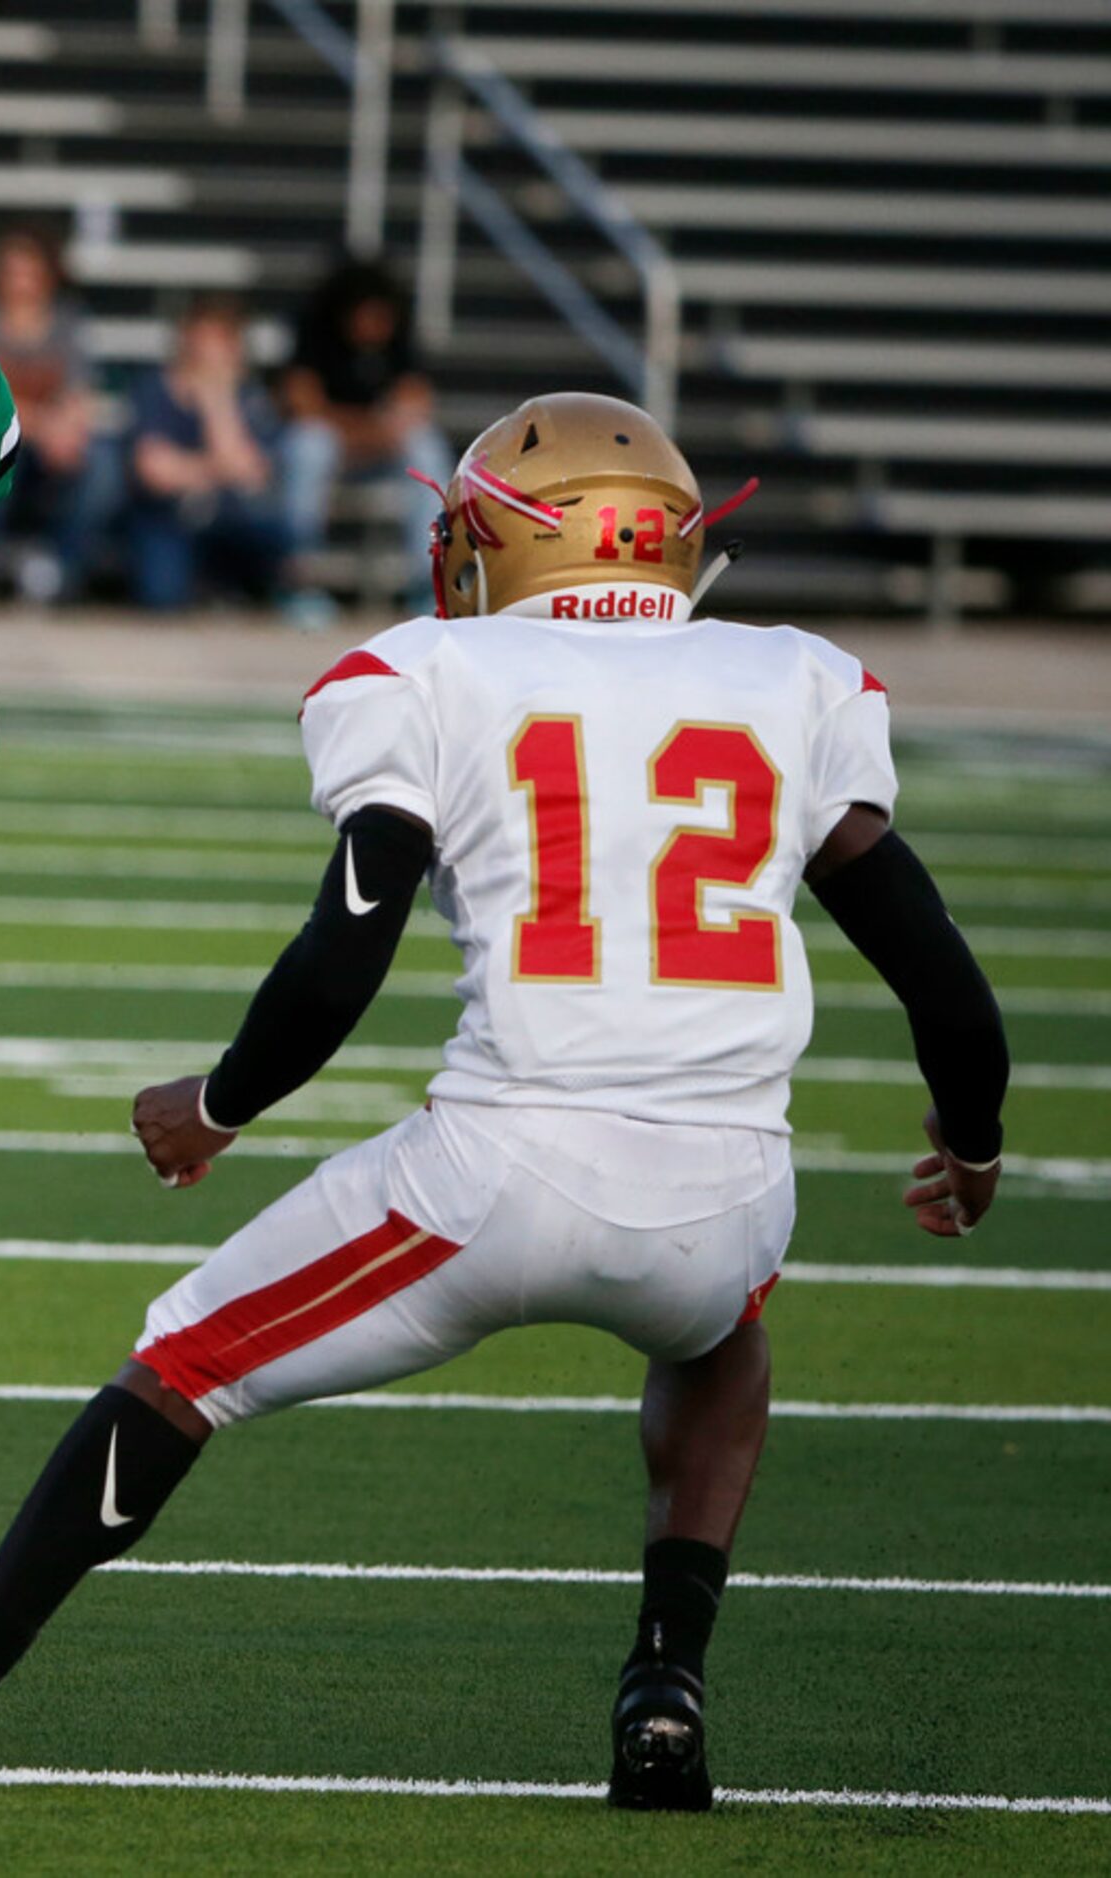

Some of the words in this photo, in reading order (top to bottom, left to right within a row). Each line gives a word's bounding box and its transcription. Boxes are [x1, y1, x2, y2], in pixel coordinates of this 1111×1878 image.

[594, 506, 665, 563] 12
[550, 591, 675, 621] Riddell
[506, 713, 784, 992] 12
